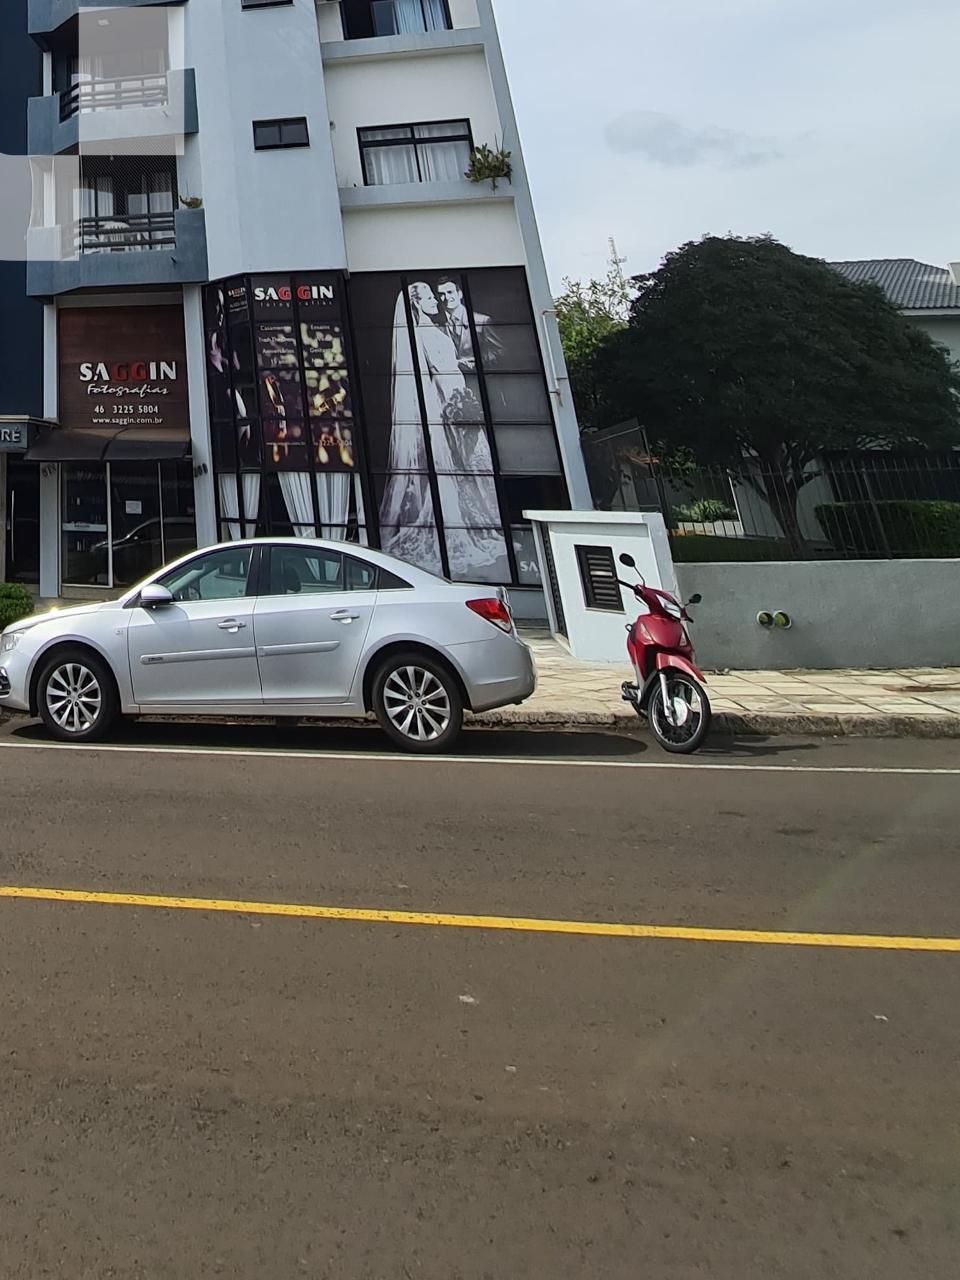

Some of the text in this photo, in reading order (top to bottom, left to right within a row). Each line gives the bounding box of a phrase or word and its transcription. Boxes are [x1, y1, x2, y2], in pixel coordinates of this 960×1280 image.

[79, 361, 177, 382] SAGGIN
[87, 383, 168, 397] Fotografias
[94, 405, 159, 414] 46 3225 5804
[92, 417, 163, 426] www.saggin.com.br
